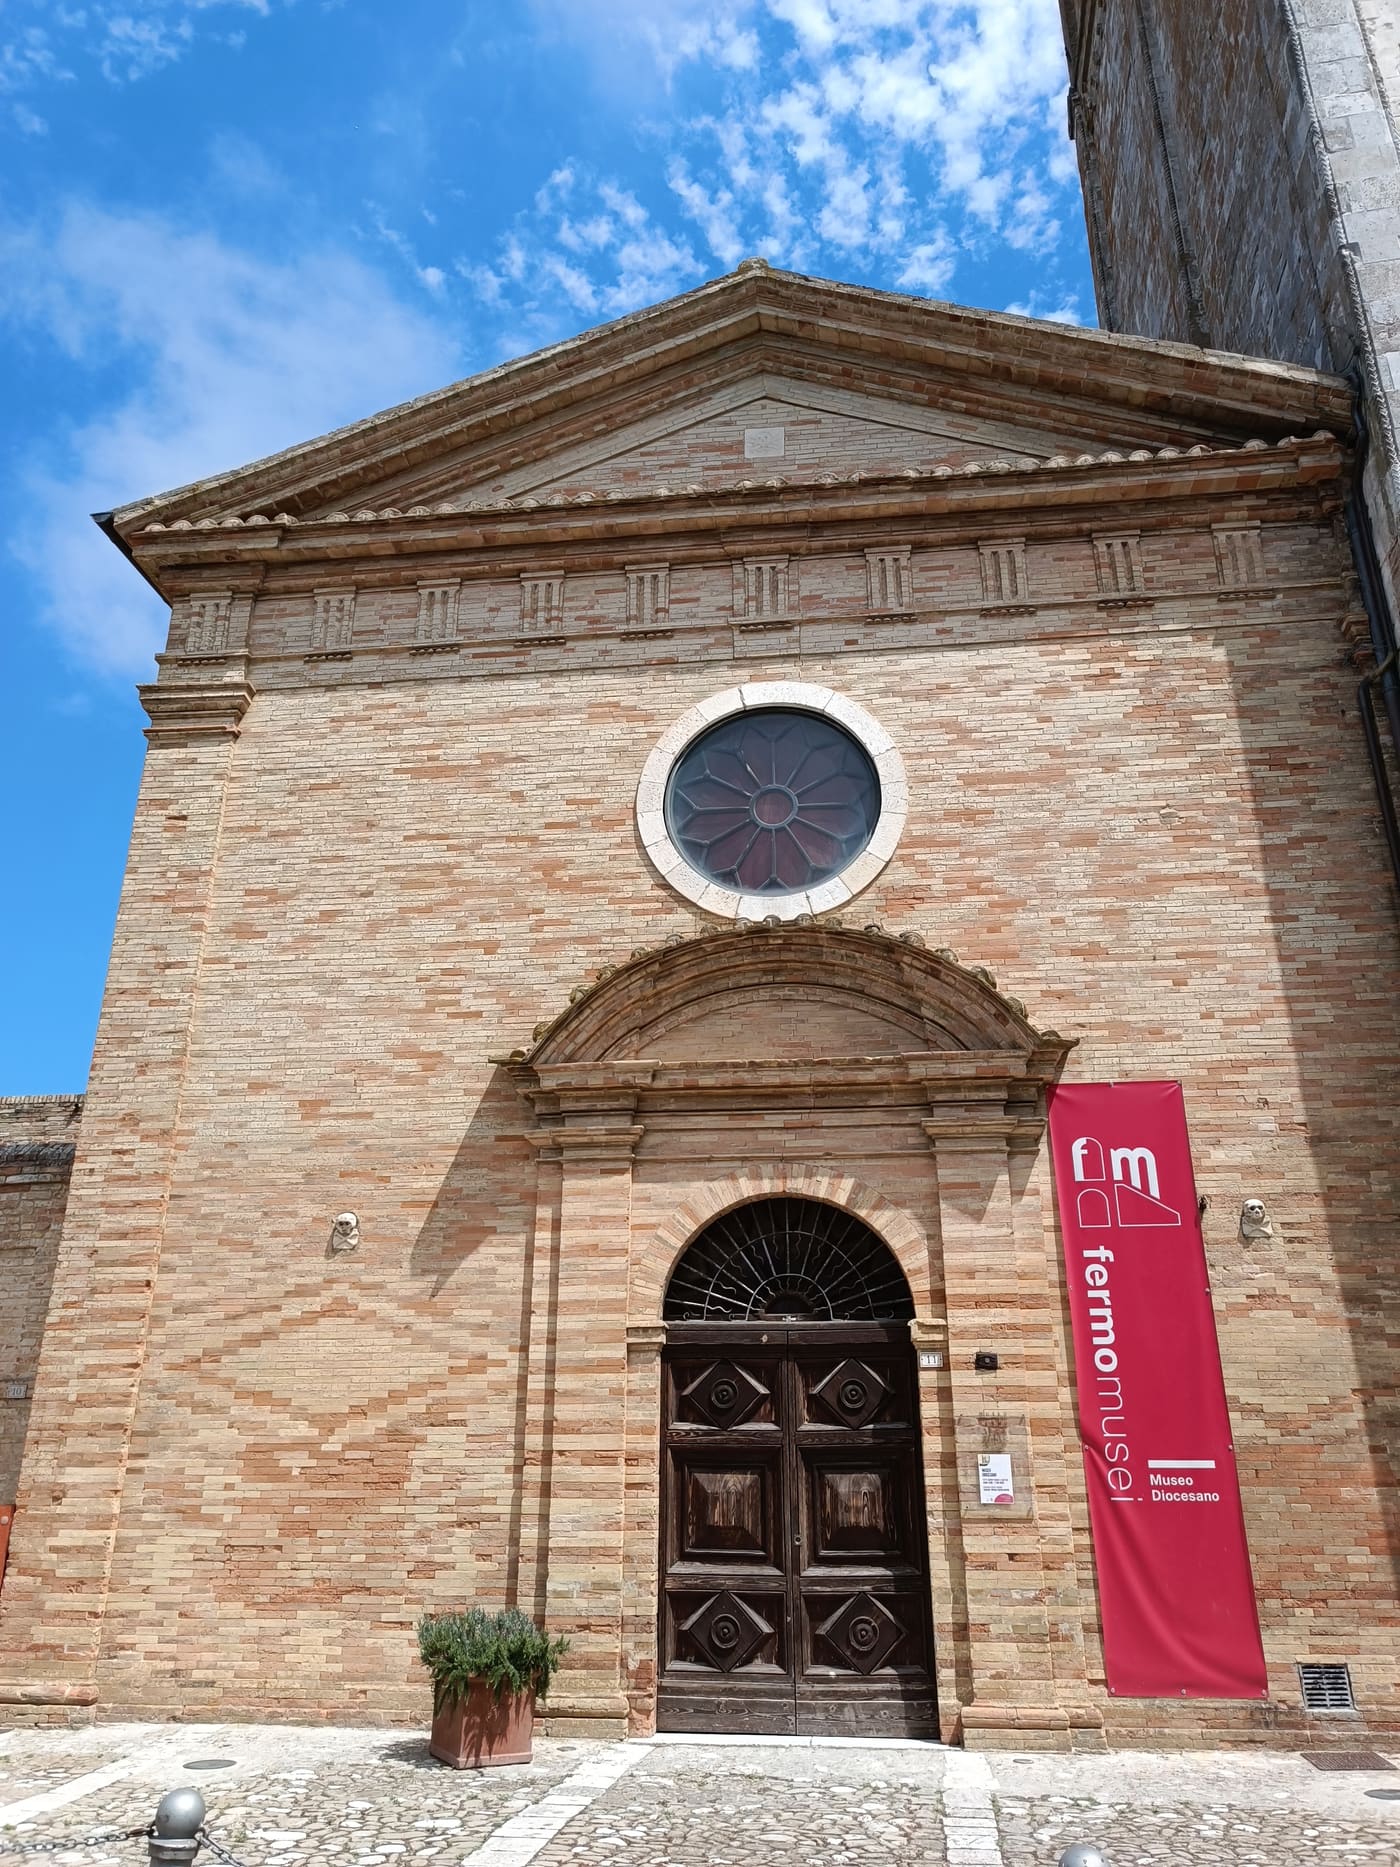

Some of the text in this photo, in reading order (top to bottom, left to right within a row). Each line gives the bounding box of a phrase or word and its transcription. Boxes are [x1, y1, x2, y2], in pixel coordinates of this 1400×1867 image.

[926, 1354, 937, 1364] 11
[1083, 1245, 1143, 1502] fermomusei
[1149, 1473, 1194, 1486] Museo
[1151, 1489, 1220, 1502] Diocesano
